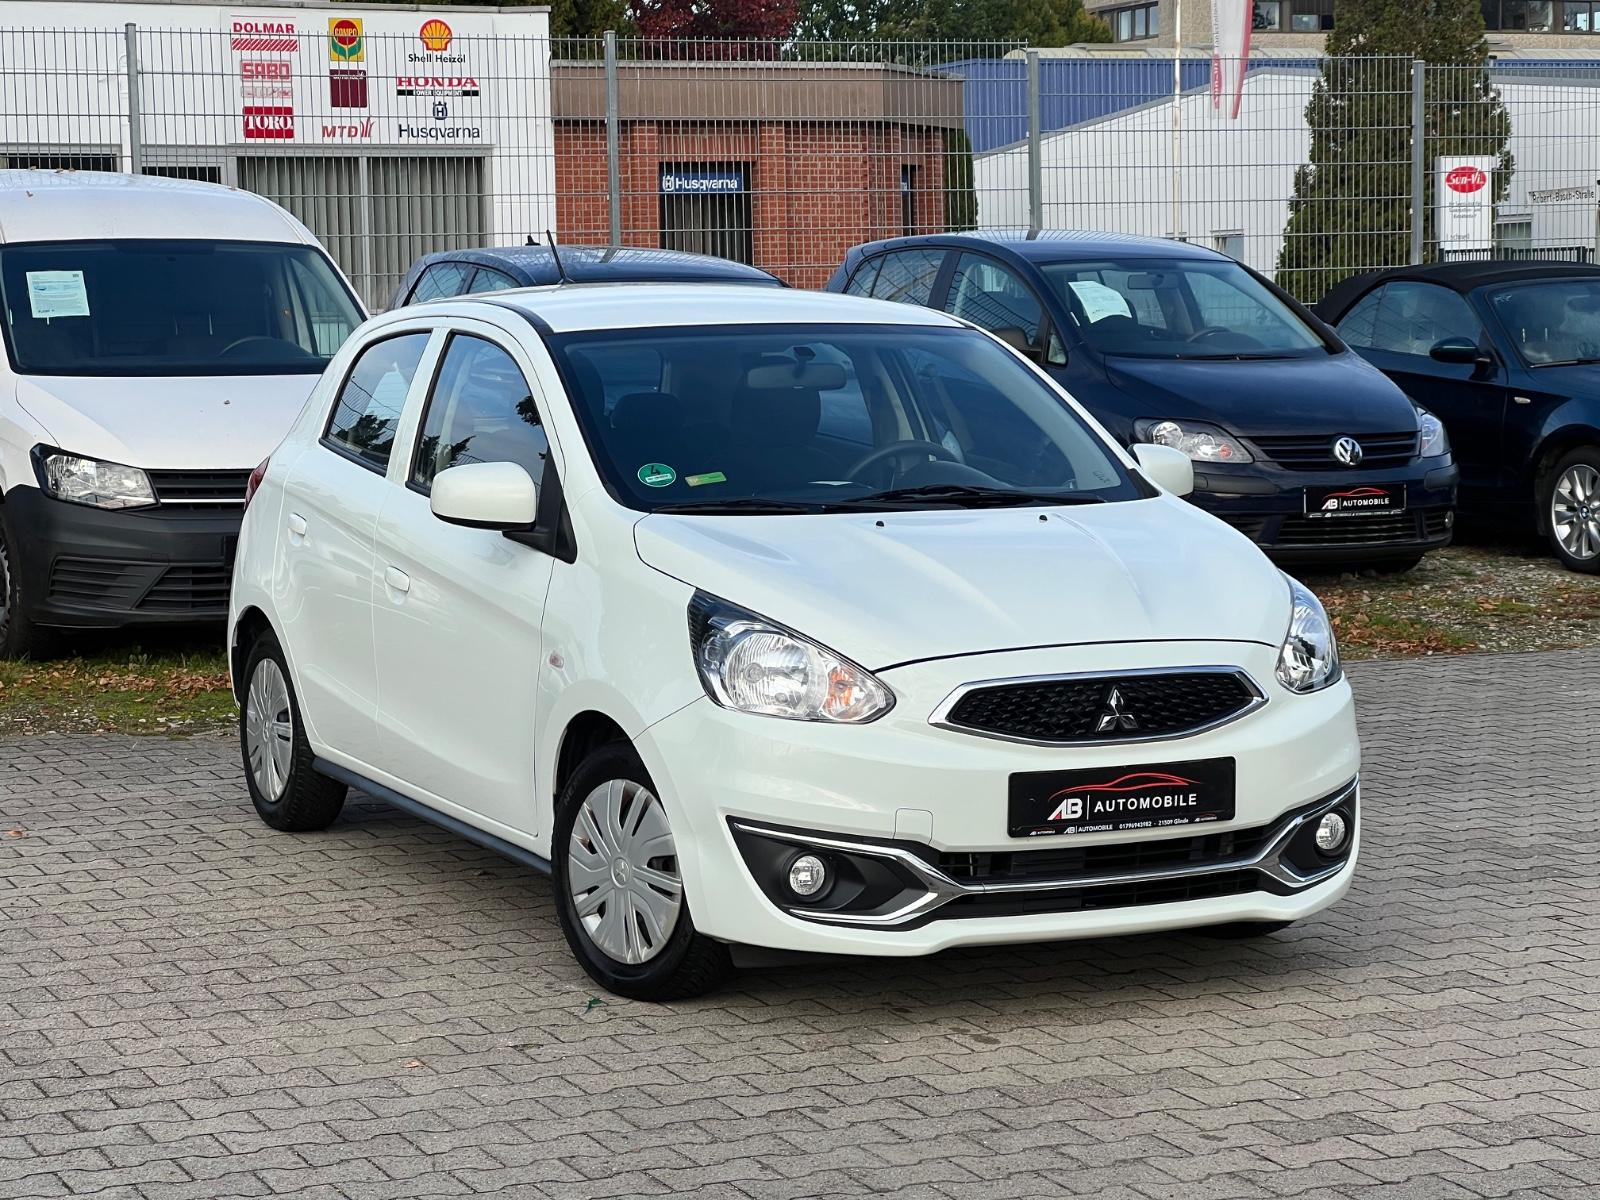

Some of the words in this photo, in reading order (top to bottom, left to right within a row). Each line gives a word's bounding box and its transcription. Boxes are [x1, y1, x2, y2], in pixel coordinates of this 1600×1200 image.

[232, 22, 295, 34] DOLMAR
[334, 27, 358, 37] COMPO
[408, 53, 432, 63] Shell
[435, 54, 466, 64] Heizöl
[243, 62, 290, 80] SABO
[397, 77, 479, 88] HONDA
[322, 125, 358, 138] MTD
[399, 123, 480, 140] Husqvarna
[675, 177, 738, 191] Husqvarna
[1342, 497, 1390, 507] AUTOMOBILE
[1094, 793, 1197, 813] AUTOMOBILE
[1078, 823, 1113, 833] AUTOMOBILE
